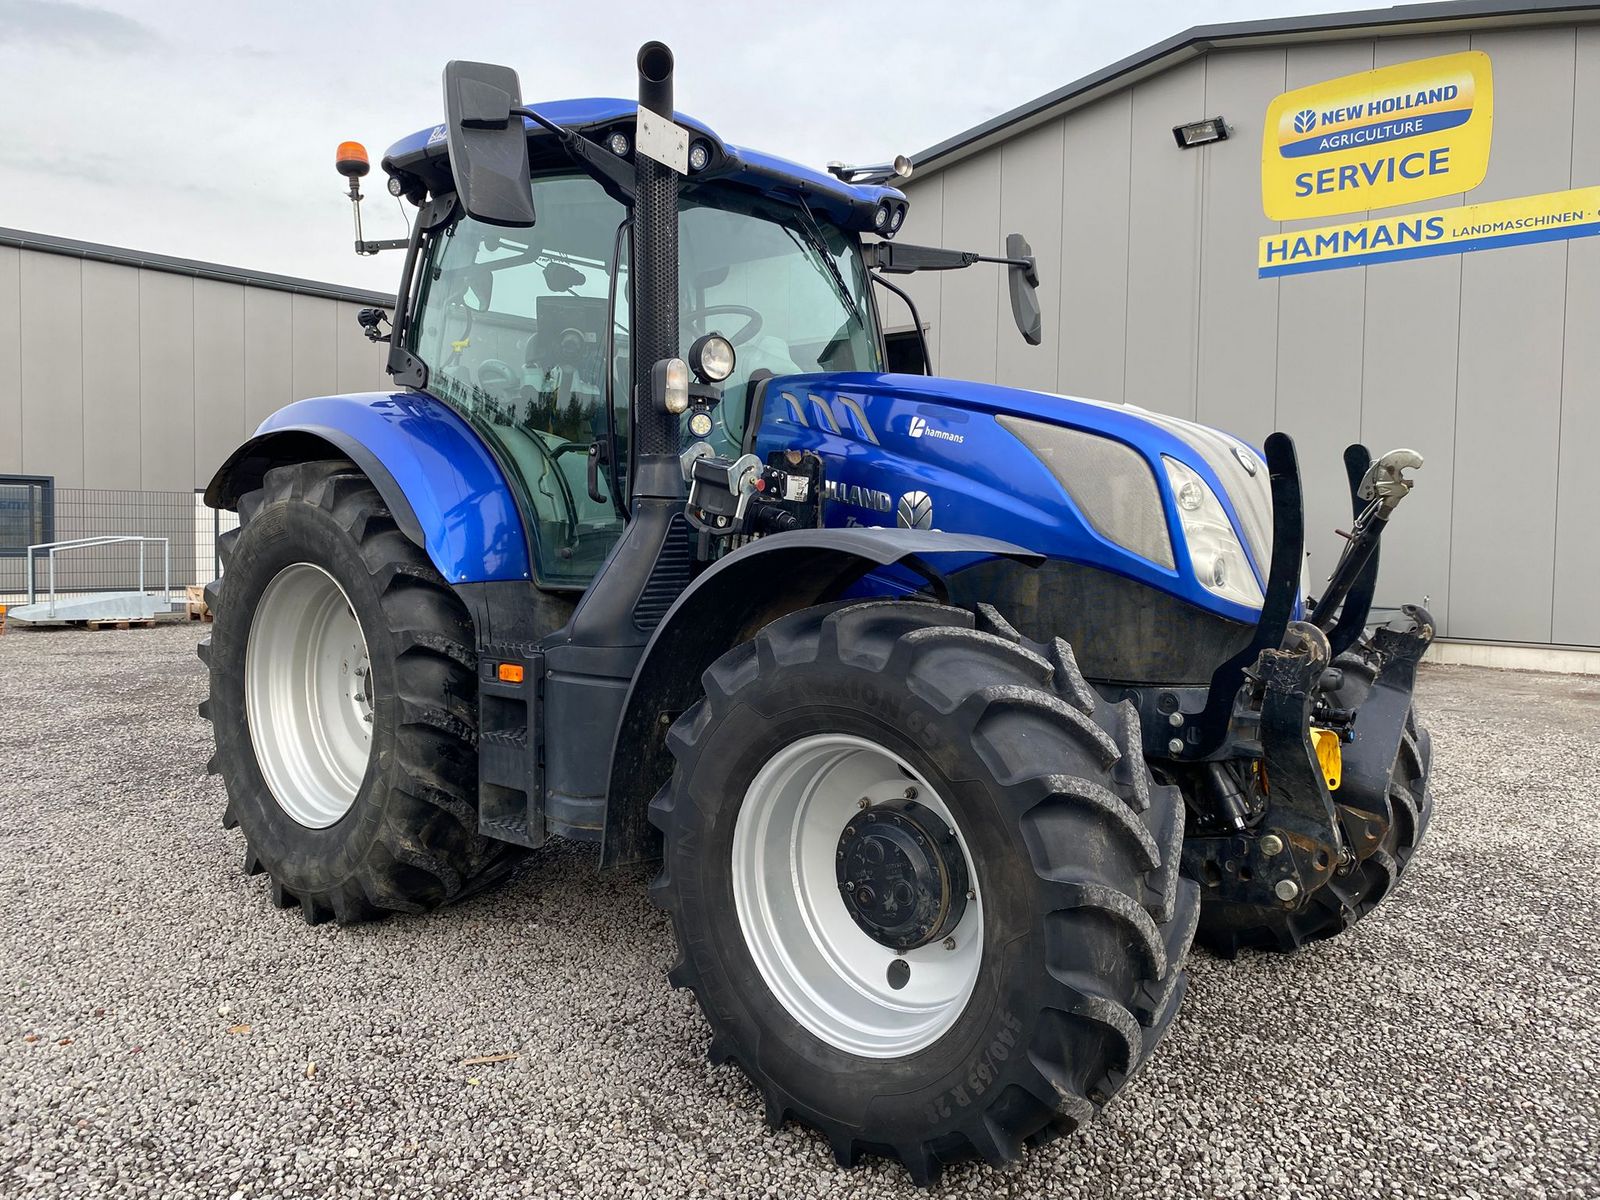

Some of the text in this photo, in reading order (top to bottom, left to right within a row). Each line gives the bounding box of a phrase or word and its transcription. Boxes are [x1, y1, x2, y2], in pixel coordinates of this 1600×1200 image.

[1321, 84, 1458, 126] NEW HOLLAND
[1319, 119, 1424, 150] AGRICULTURE
[1295, 147, 1450, 198] SERVICE
[1266, 210, 1584, 263] HAMMANS LANDMASCHINEN
[925, 425, 964, 444] hammans
[825, 479, 892, 513] LLAND
[950, 1084, 972, 1107] R
